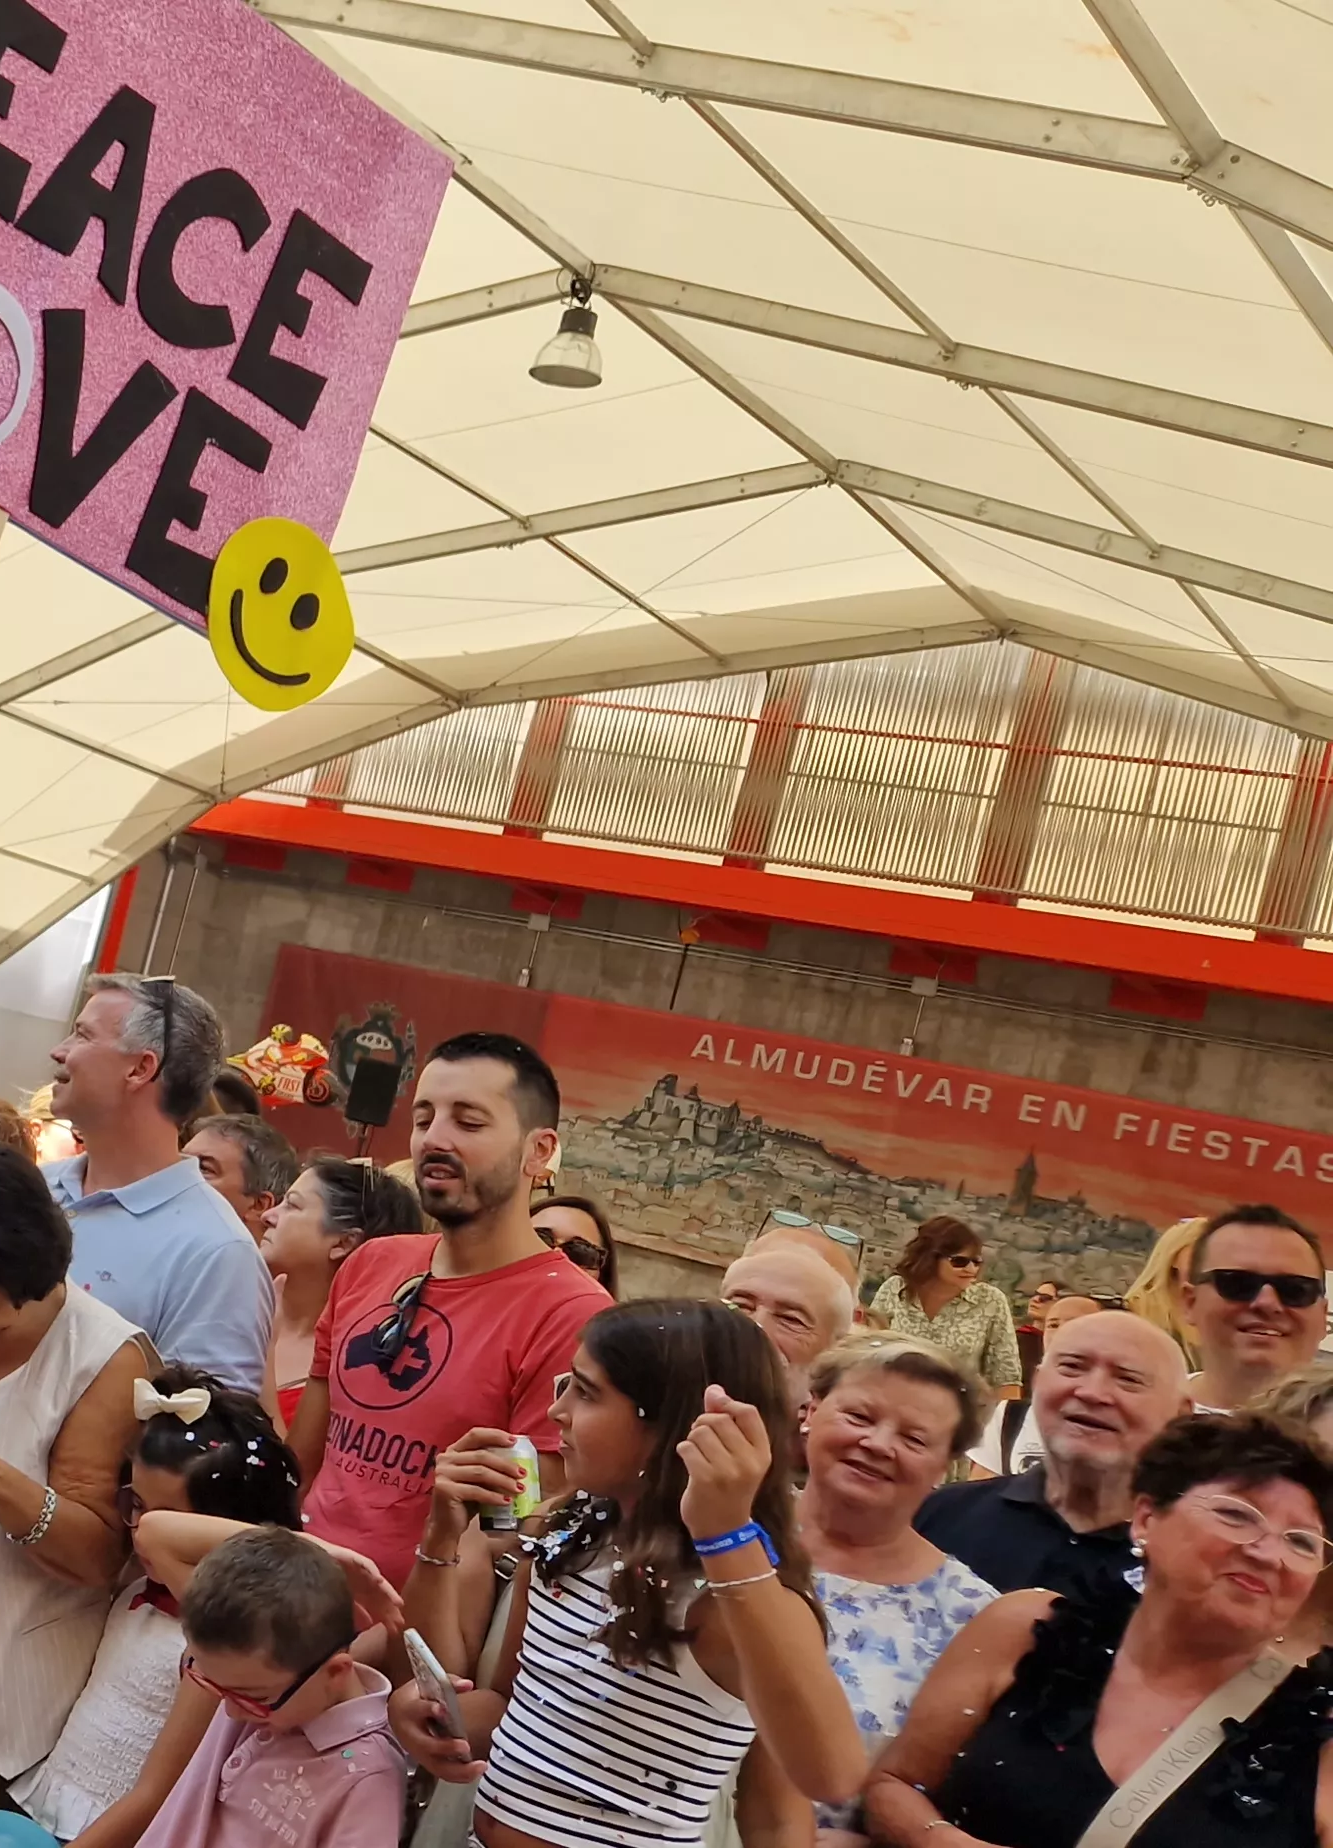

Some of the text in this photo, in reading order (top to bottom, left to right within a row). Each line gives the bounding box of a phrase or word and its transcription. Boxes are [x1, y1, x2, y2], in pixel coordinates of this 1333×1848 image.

[690, 1033, 1333, 1184] ALMUDÉVAR EN FIESTAS
[1109, 1724, 1219, 1830] Calvin Klein
